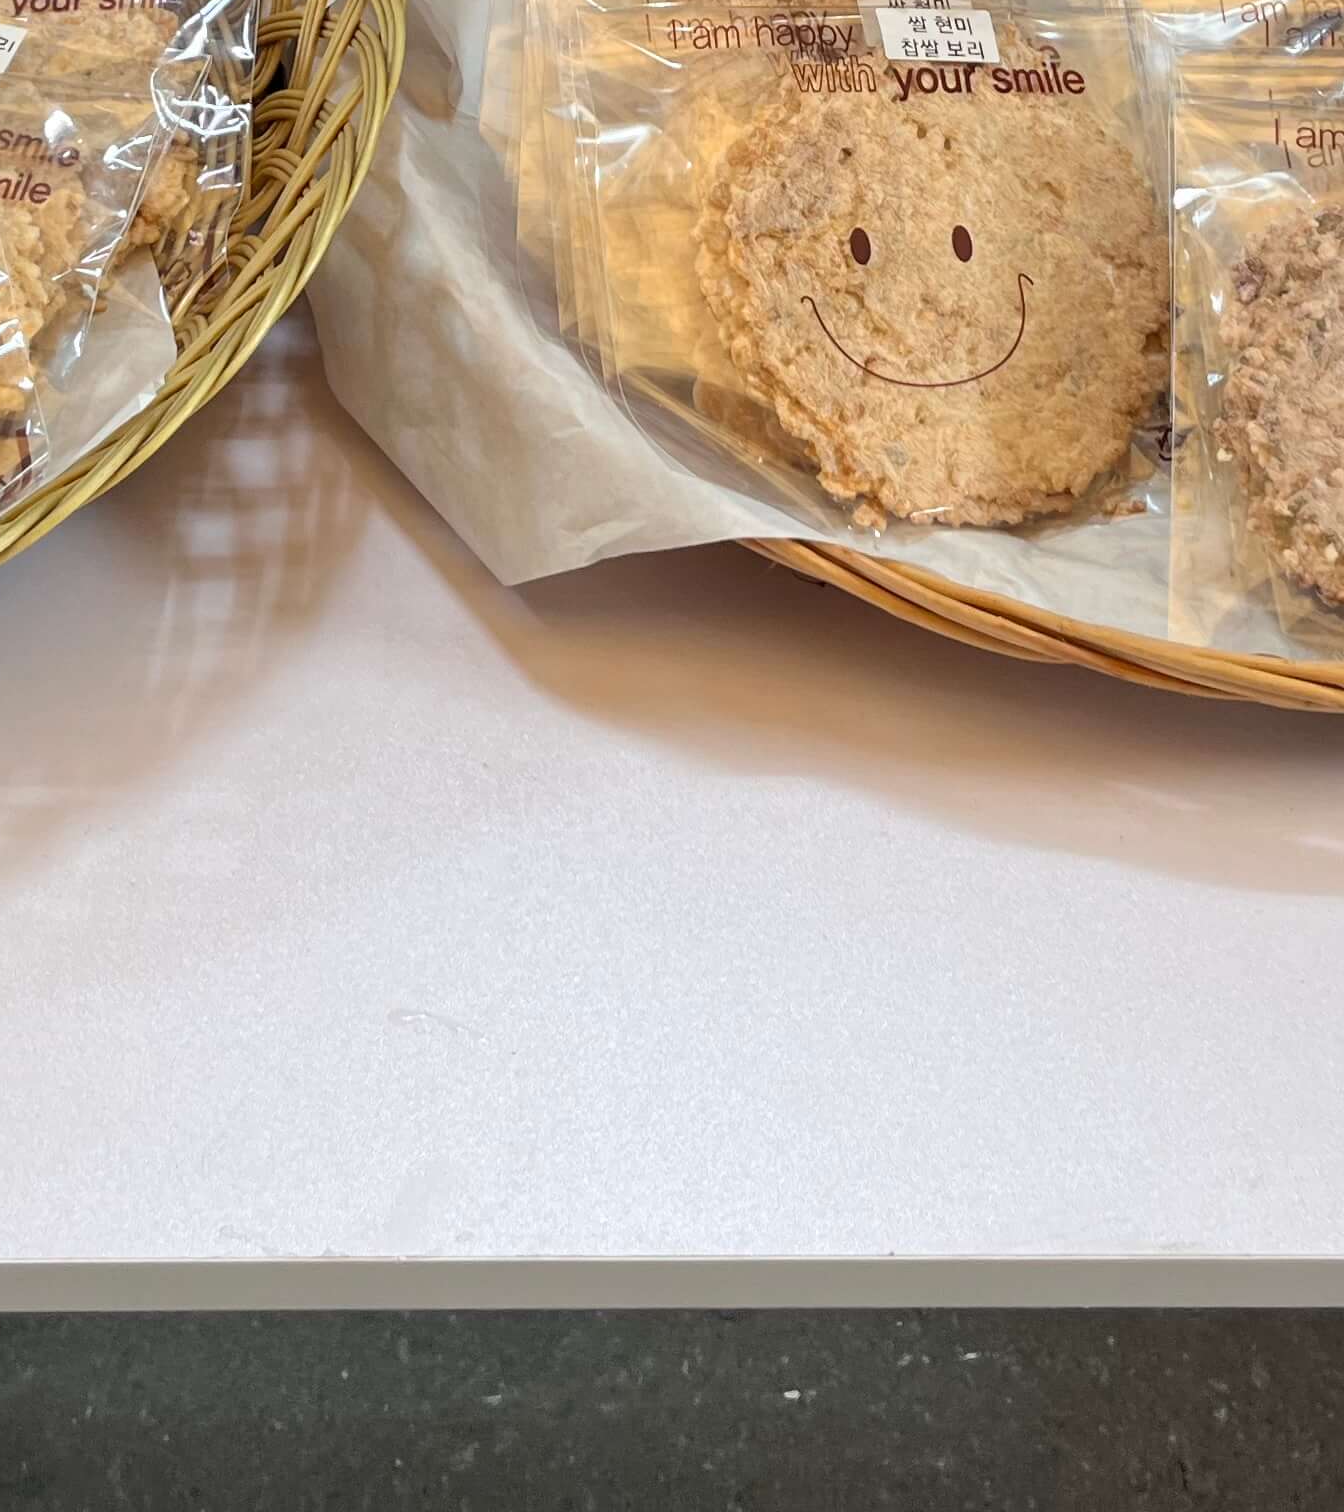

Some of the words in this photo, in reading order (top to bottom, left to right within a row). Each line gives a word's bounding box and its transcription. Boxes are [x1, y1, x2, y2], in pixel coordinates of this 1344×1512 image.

[693, 25, 741, 50] am
[756, 17, 853, 55] happy
[908, 15, 927, 33] 쌀
[935, 15, 974, 36] 현미
[901, 37, 940, 58] 찹쌀
[948, 38, 986, 59] 보리
[792, 57, 876, 94] with
[893, 65, 975, 103] your
[992, 64, 1086, 96] smile
[1274, 119, 1280, 145] I
